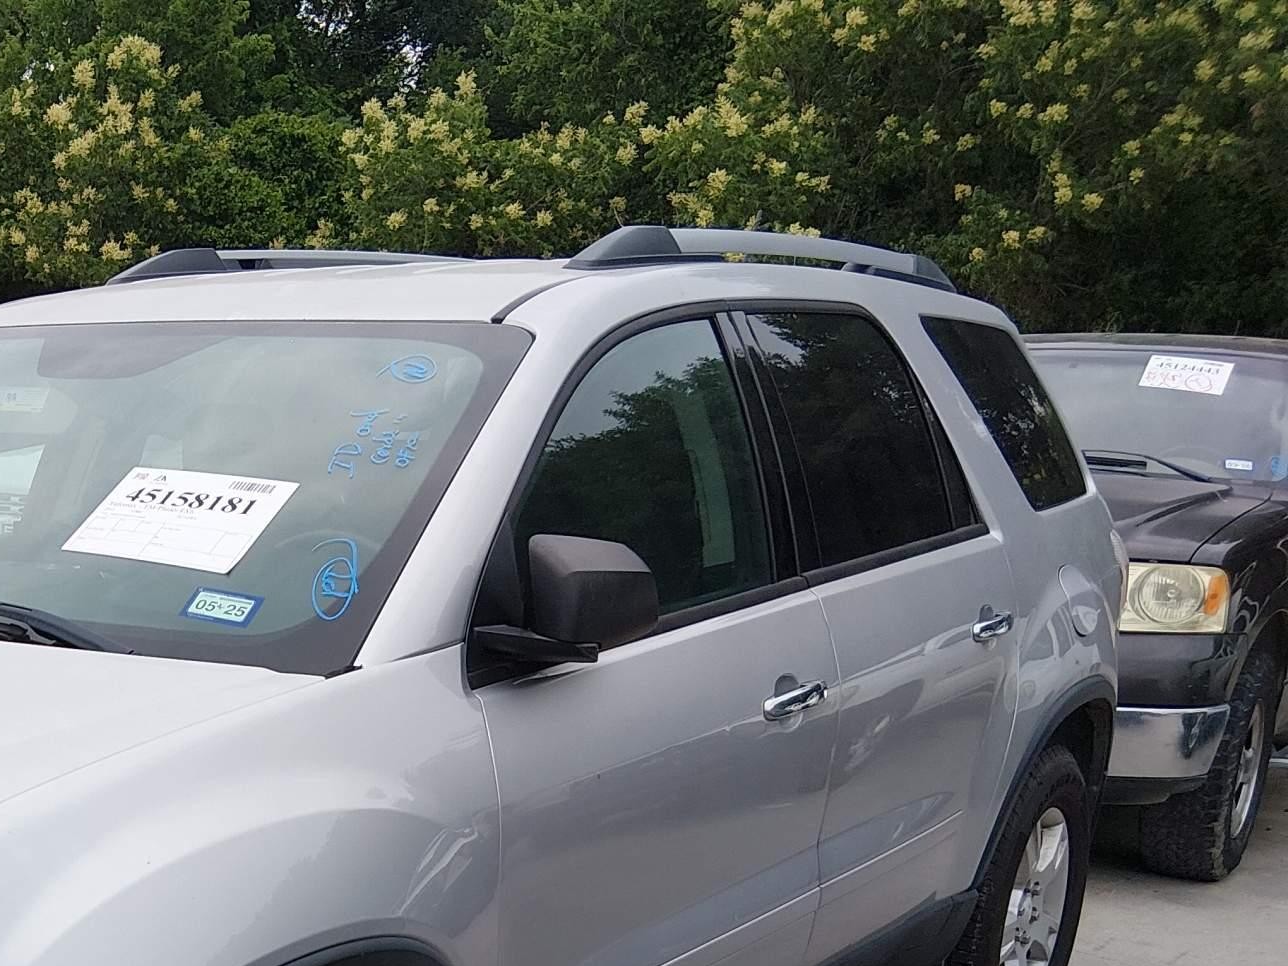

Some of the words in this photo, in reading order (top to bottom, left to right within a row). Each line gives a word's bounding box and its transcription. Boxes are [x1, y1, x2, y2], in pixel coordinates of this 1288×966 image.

[126, 487, 258, 515] 45158181
[195, 599, 218, 612] 05
[223, 604, 248, 617] 25
